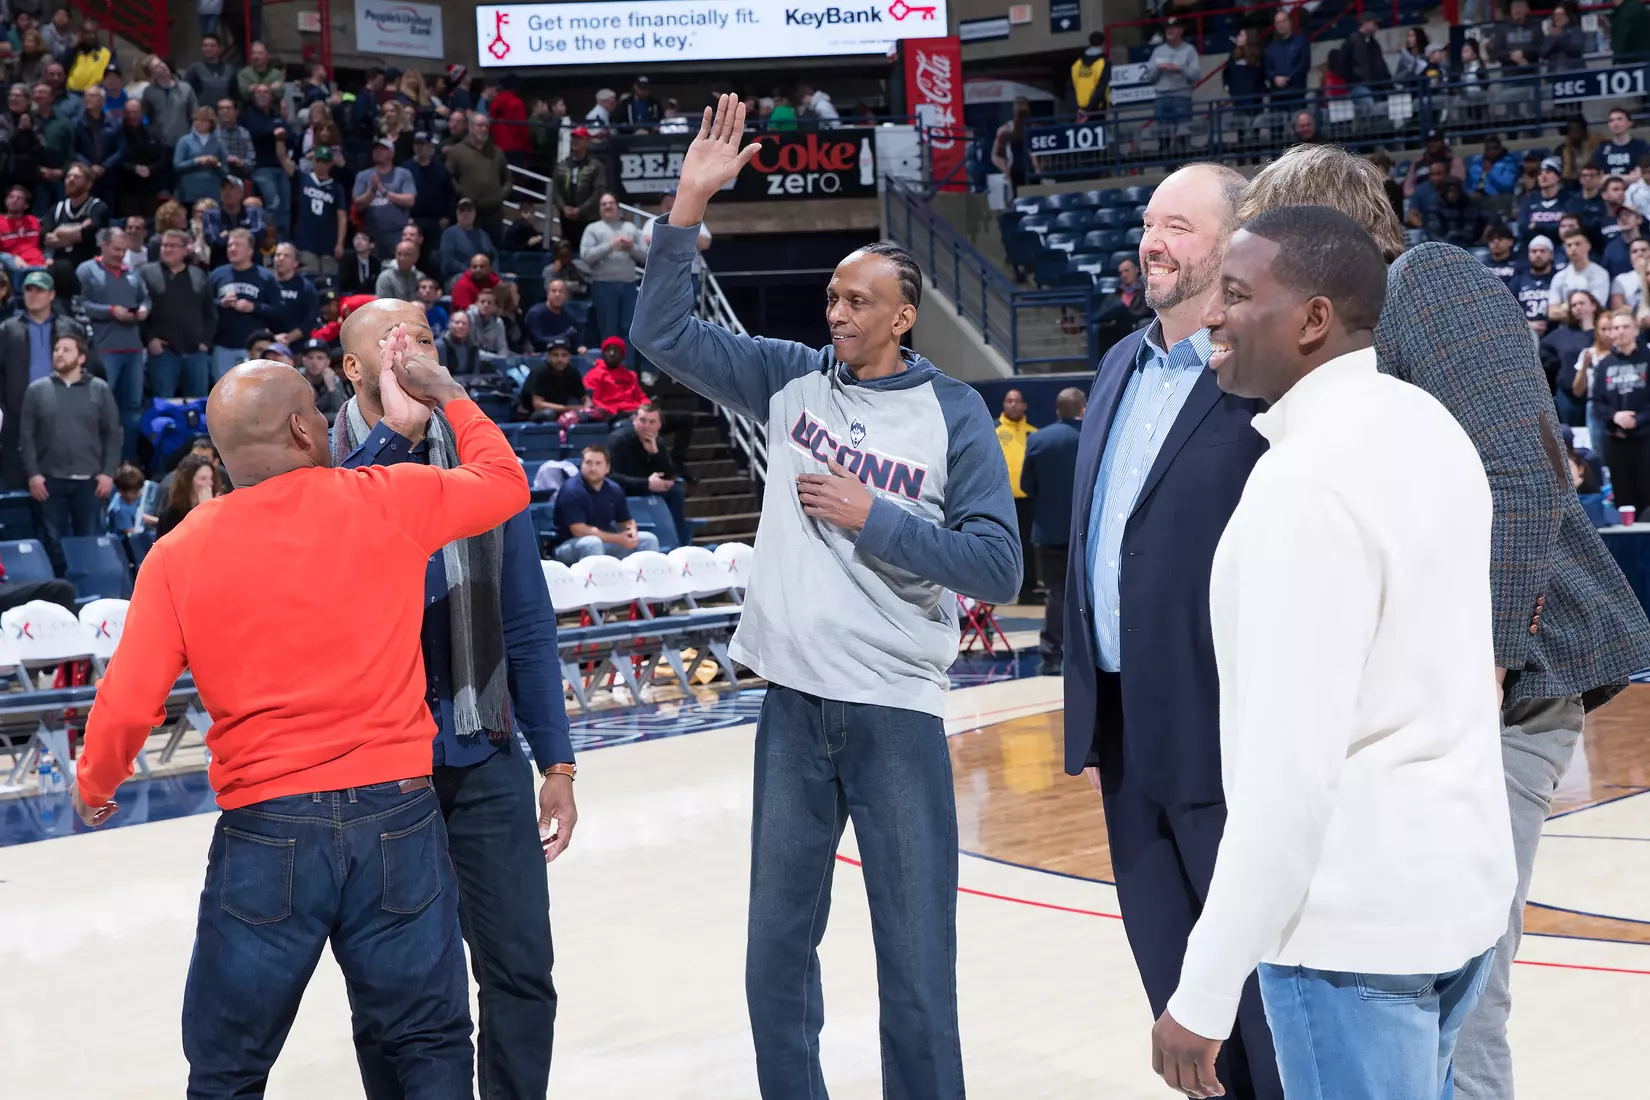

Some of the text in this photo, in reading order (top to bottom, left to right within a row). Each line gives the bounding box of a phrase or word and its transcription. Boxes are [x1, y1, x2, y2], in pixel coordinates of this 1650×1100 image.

[528, 8, 760, 31] Get more financially fit.
[785, 7, 883, 29] KeyBank
[528, 36, 567, 52] Use
[575, 35, 606, 51] the
[613, 33, 645, 50] red
[1112, 69, 1129, 82] EC
[1554, 69, 1645, 96] SEC 101
[1031, 126, 1104, 149] SEC 101
[751, 133, 856, 173] Coke
[766, 172, 841, 195] zero
[790, 411, 926, 500] UCONN
